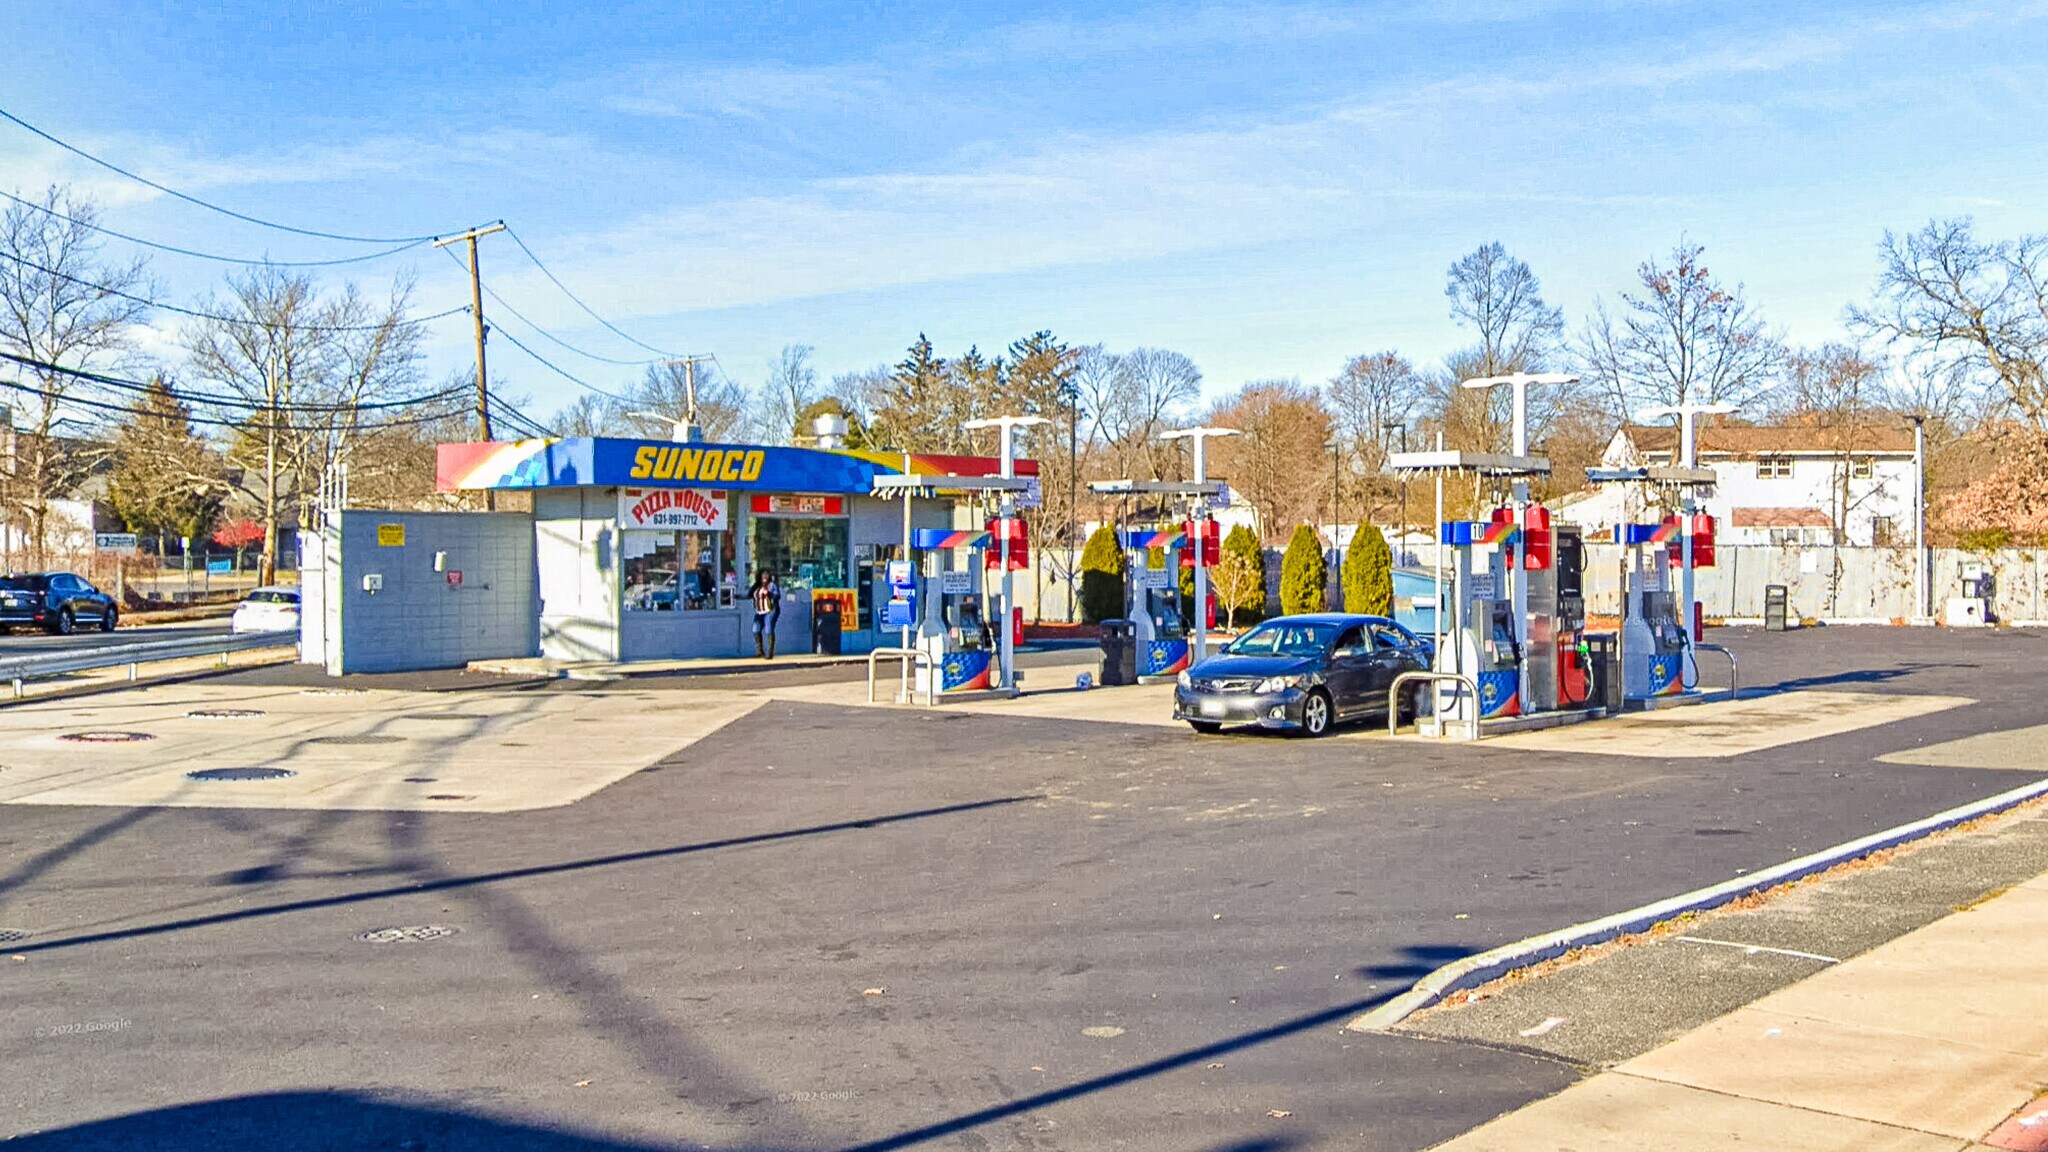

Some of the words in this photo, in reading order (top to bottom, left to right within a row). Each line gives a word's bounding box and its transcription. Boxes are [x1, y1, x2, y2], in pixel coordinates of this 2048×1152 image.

[630, 446, 765, 482] SUNOCO
[632, 490, 671, 525] PIZZA
[674, 488, 719, 525] HOUSE
[653, 513, 698, 525] 631-997-7712
[1473, 525, 1484, 538] 10
